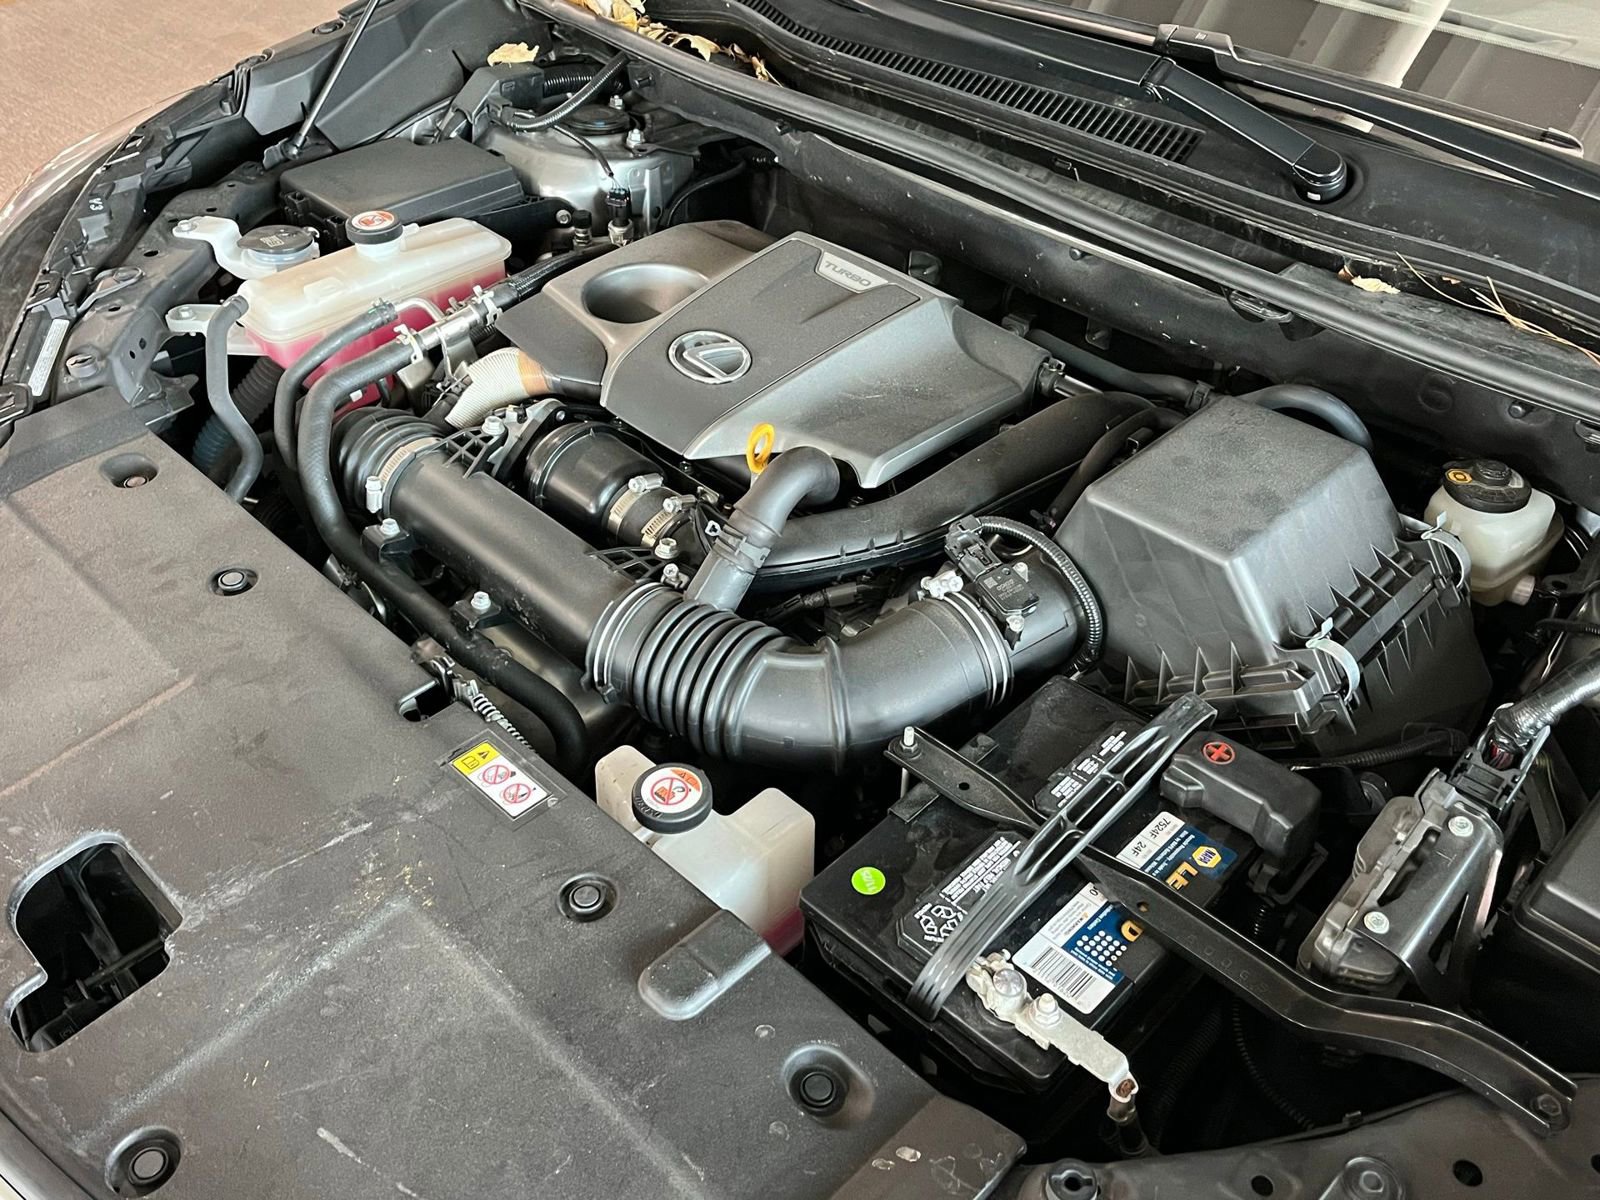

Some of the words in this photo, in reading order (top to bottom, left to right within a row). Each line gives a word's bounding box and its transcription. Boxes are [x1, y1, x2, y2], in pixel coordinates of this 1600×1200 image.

[824, 261, 871, 287] TURBO
[1149, 817, 1171, 839] 7524F
[1131, 841, 1147, 857] 24F
[1197, 848, 1217, 865] NAPA
